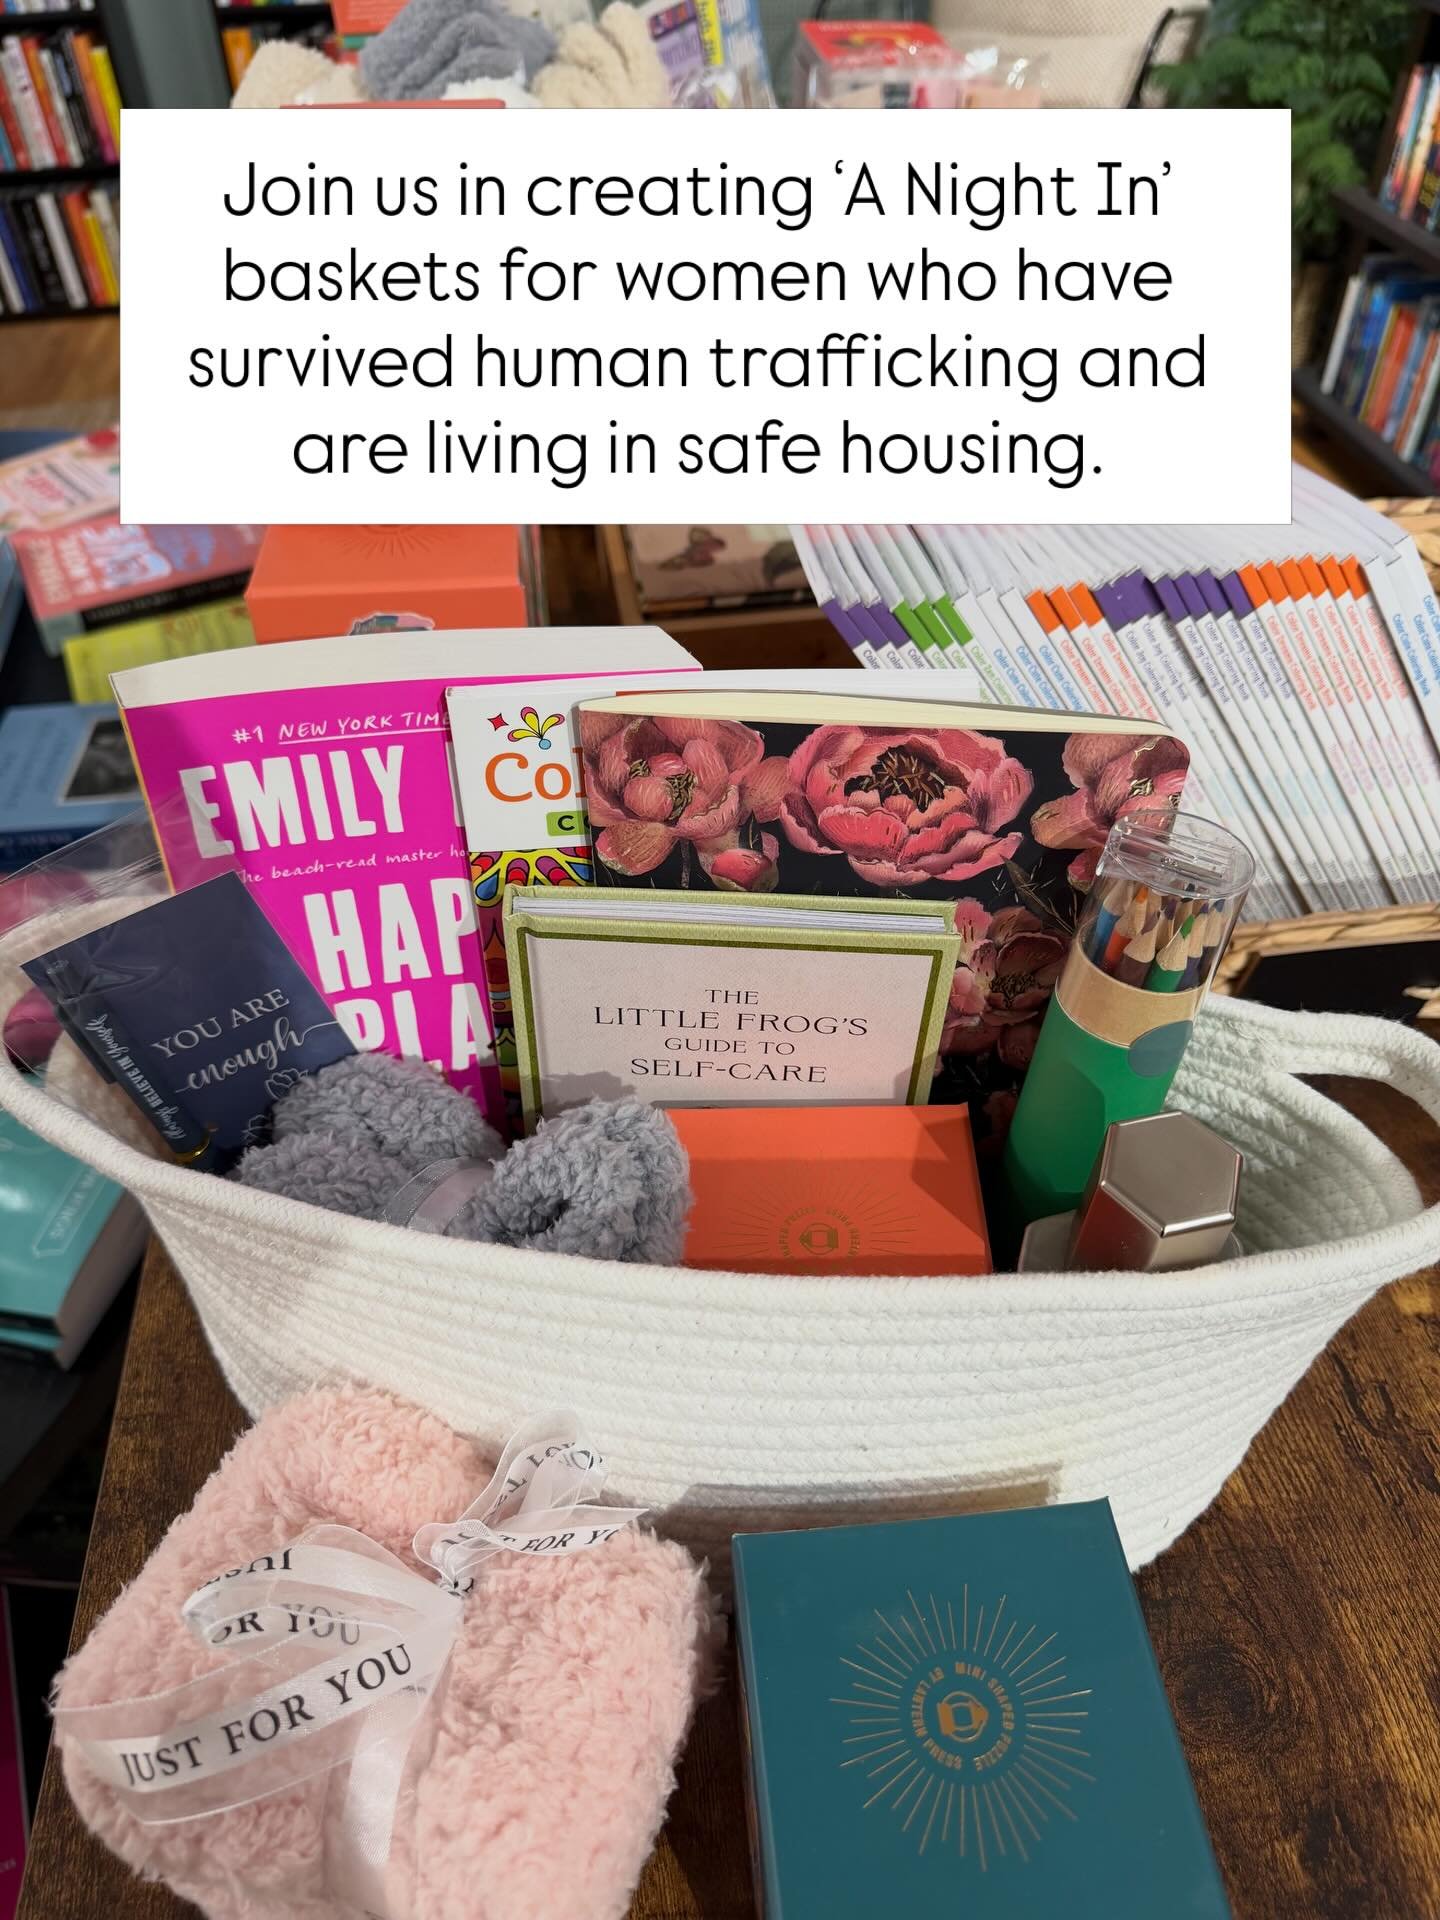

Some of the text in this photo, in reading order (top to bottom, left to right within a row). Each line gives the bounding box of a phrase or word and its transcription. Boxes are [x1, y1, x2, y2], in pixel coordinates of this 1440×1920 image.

[1422, 595, 1436, 615] Color
[1412, 614, 1427, 634] Color
[907, 648, 924, 669] Color
[970, 645, 987, 665] Color
[993, 648, 1010, 668] Color
[1015, 645, 1032, 665] Color
[1037, 645, 1055, 666] Color
[1391, 614, 1432, 696] Color Cute Coloring Book
[232, 726, 263, 744] #1
[279, 720, 327, 740] NEW
[337, 714, 393, 735] YORK
[179, 745, 405, 859] EMILY
[271, 854, 376, 881] beach-read
[386, 850, 443, 868] master
[303, 877, 478, 994] HAP
[705, 989, 760, 1005] THE
[152, 988, 290, 1058] YOU ARE
[594, 1006, 720, 1030] LITTLE
[174, 1016, 337, 1093] enough
[664, 1037, 795, 1056] GUIDE TO
[116, 1053, 135, 1072] IN
[630, 1058, 828, 1083] SELF-CARE
[126, 1063, 164, 1111] BELIEVE
[520, 1532, 576, 1552] FOR
[121, 1643, 412, 1785] JUST FOR YOU
